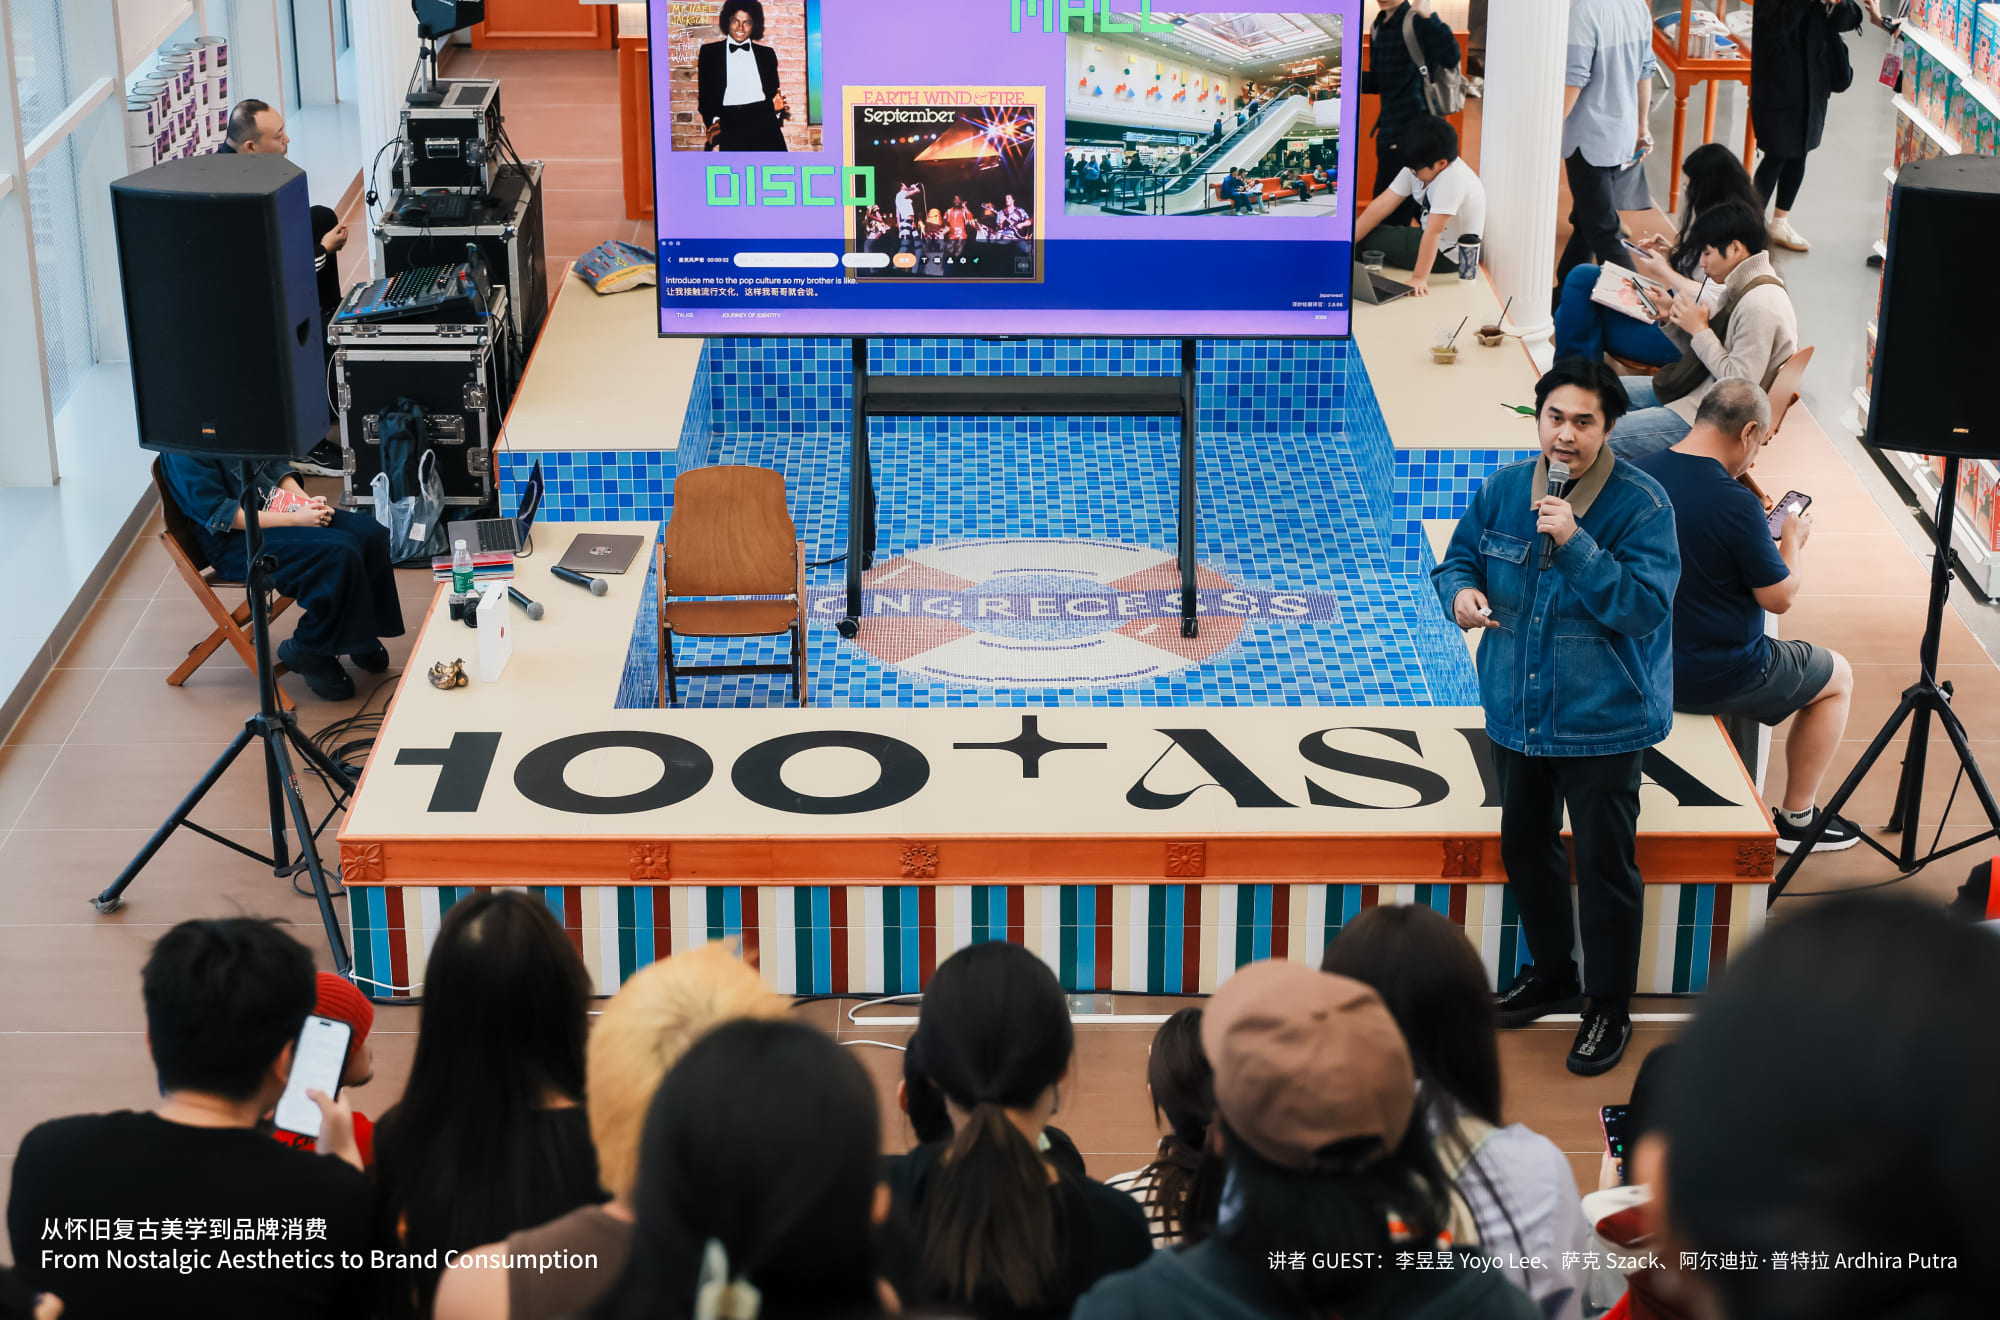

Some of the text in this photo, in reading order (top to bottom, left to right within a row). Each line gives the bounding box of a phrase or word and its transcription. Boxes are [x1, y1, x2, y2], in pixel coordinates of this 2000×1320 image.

[671, 4, 716, 14] MICHAEL
[671, 14, 709, 26] JACKSON
[1010, 0, 1175, 33] MALL
[671, 30, 694, 41] OFF
[863, 91, 919, 105] EARTH
[922, 91, 973, 105] WIND
[988, 91, 1025, 105] FIRE
[863, 108, 955, 125] September
[705, 165, 876, 206] DISCO
[665, 276, 701, 285] Introduce
[715, 276, 724, 285] to
[724, 276, 738, 285] the
[738, 278, 754, 286] pop
[755, 276, 782, 285] culture
[793, 278, 805, 286] my
[806, 276, 834, 285] brother
[835, 276, 842, 285] is
